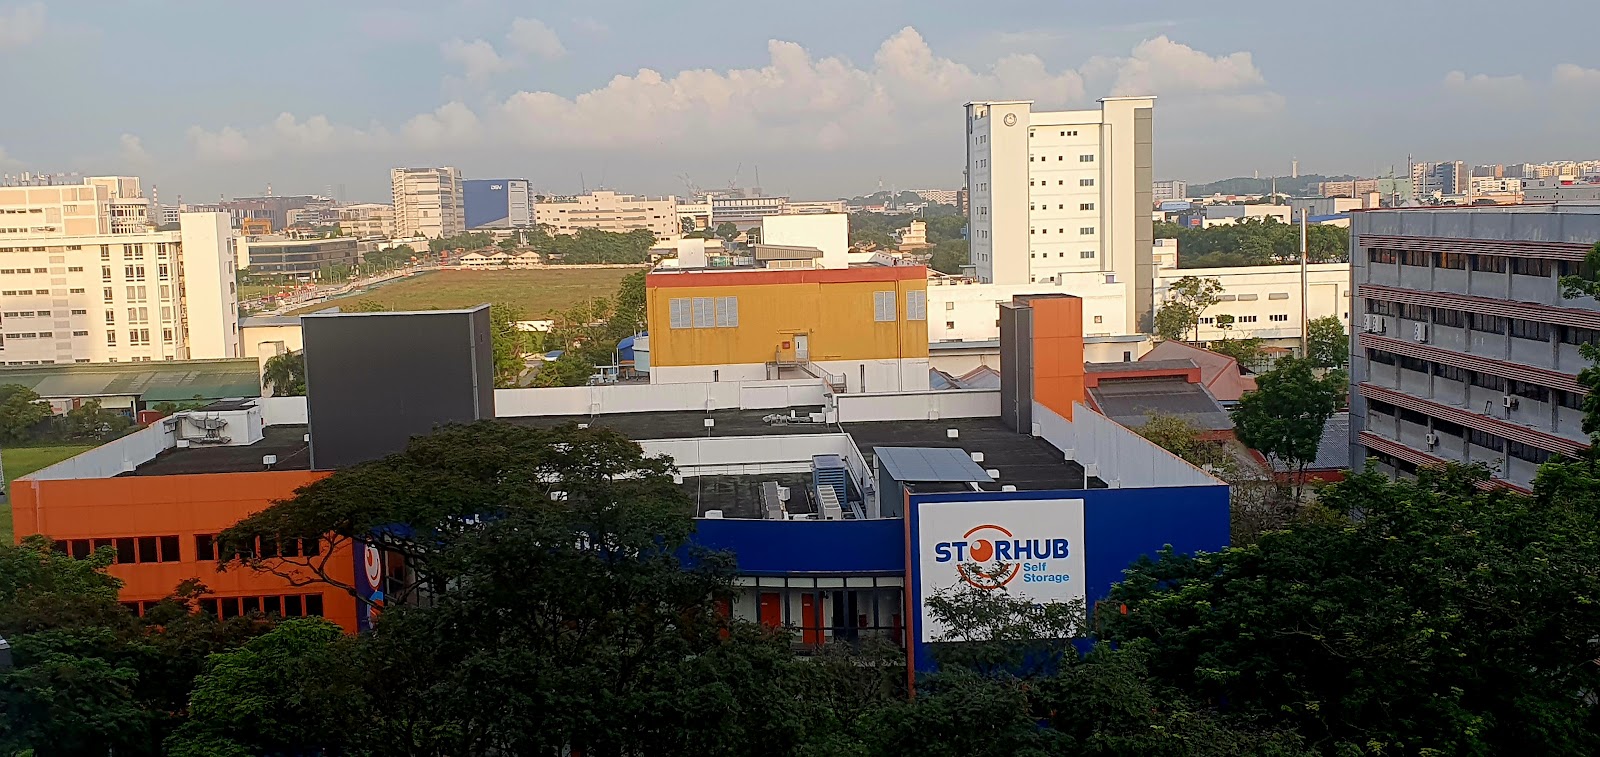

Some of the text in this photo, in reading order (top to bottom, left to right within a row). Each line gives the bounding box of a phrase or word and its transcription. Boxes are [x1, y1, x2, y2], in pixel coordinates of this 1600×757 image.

[935, 539, 1069, 562] STORHUB
[1023, 562, 1046, 572] Self
[1023, 573, 1070, 583] Storage
